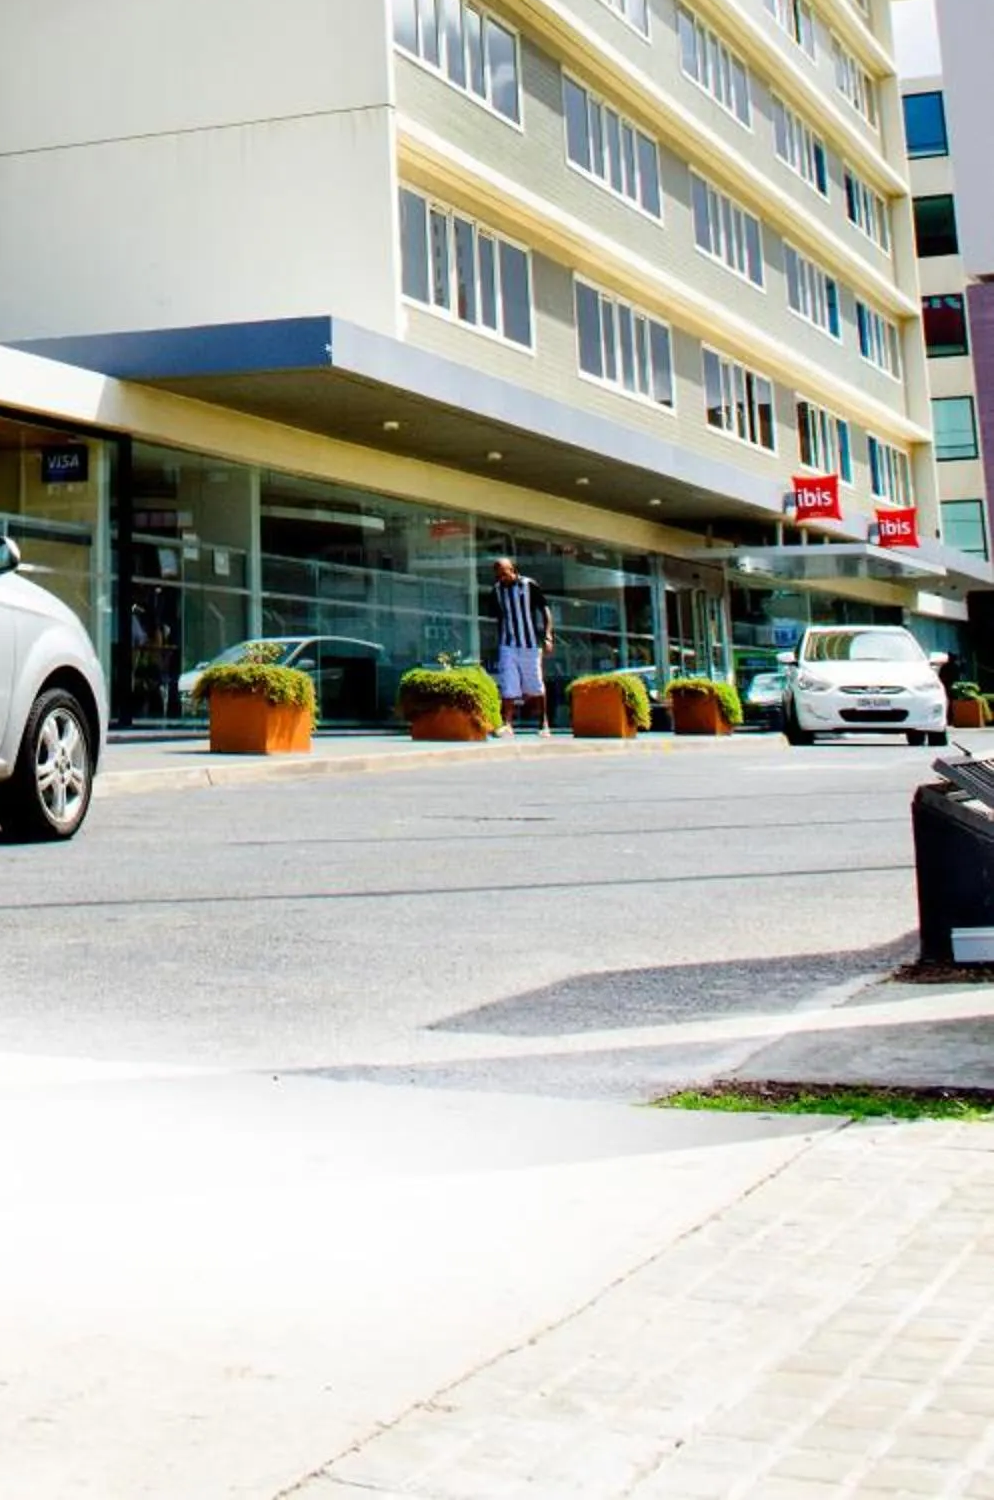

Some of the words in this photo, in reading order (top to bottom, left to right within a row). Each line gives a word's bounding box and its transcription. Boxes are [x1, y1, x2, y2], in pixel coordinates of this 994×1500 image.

[47, 453, 80, 469] VISA
[797, 487, 833, 508] ibis
[880, 519, 911, 536] ibis
